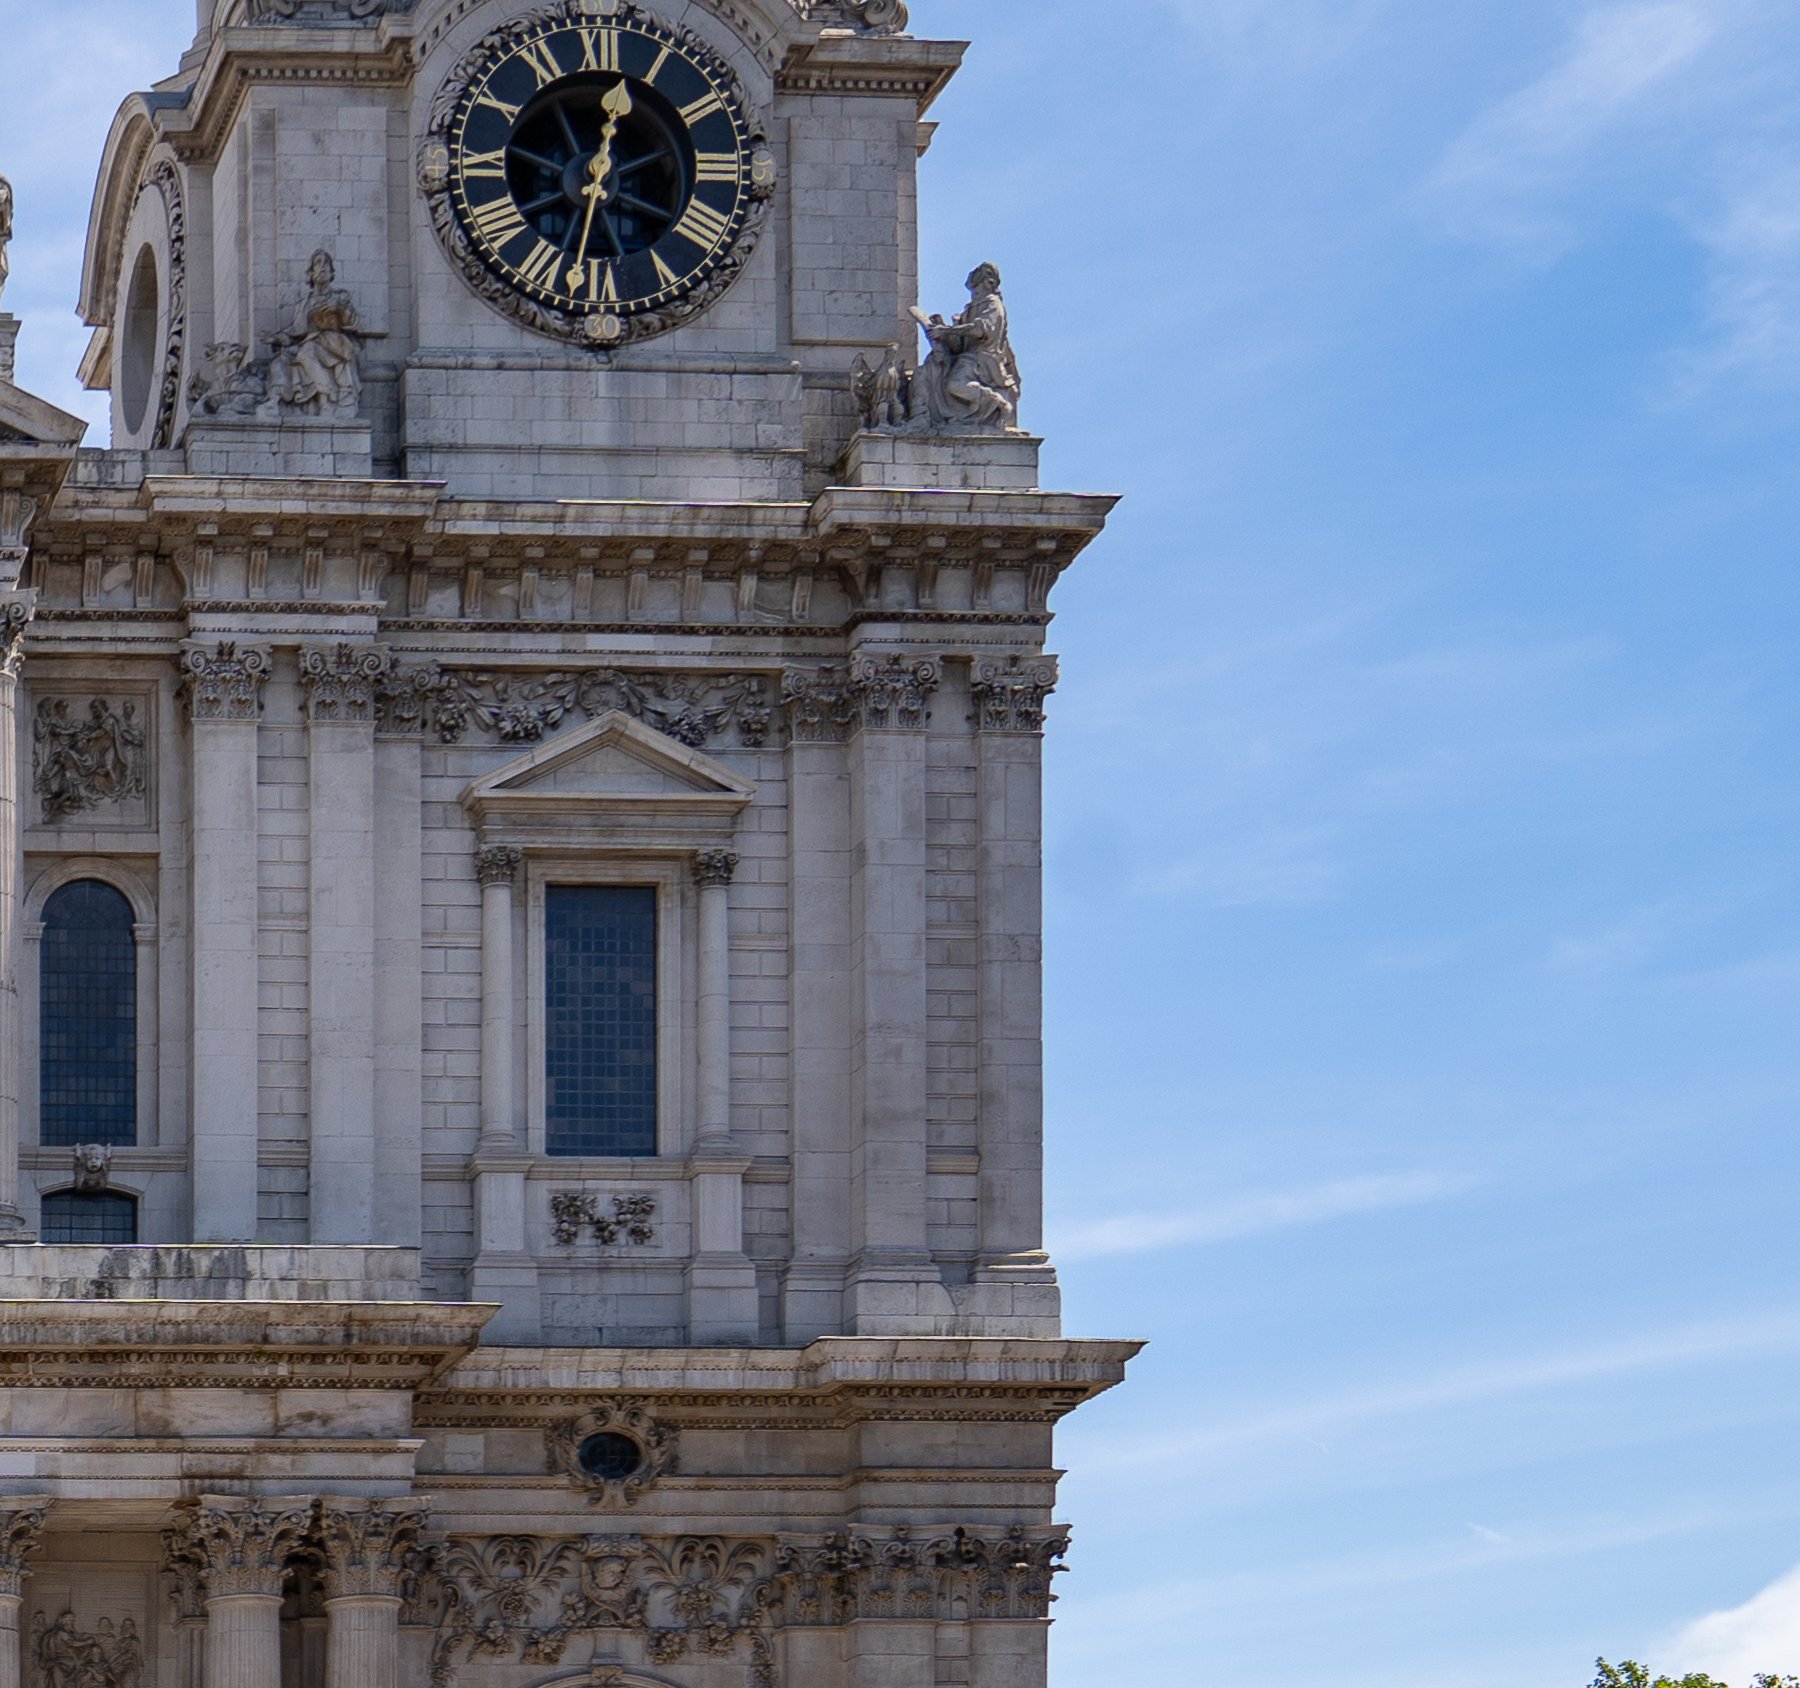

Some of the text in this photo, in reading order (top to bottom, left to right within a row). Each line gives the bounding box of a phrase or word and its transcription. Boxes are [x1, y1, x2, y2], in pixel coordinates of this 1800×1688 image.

[516, 38, 567, 91] XI
[577, 29, 622, 72] XII
[474, 84, 524, 126] X
[676, 88, 724, 128] II
[462, 146, 506, 180] IX
[695, 149, 738, 184] III
[470, 191, 529, 252] VIII
[514, 236, 564, 292] VII
[585, 258, 622, 302] VI
[650, 249, 682, 289] V
[584, 314, 620, 339] 30
